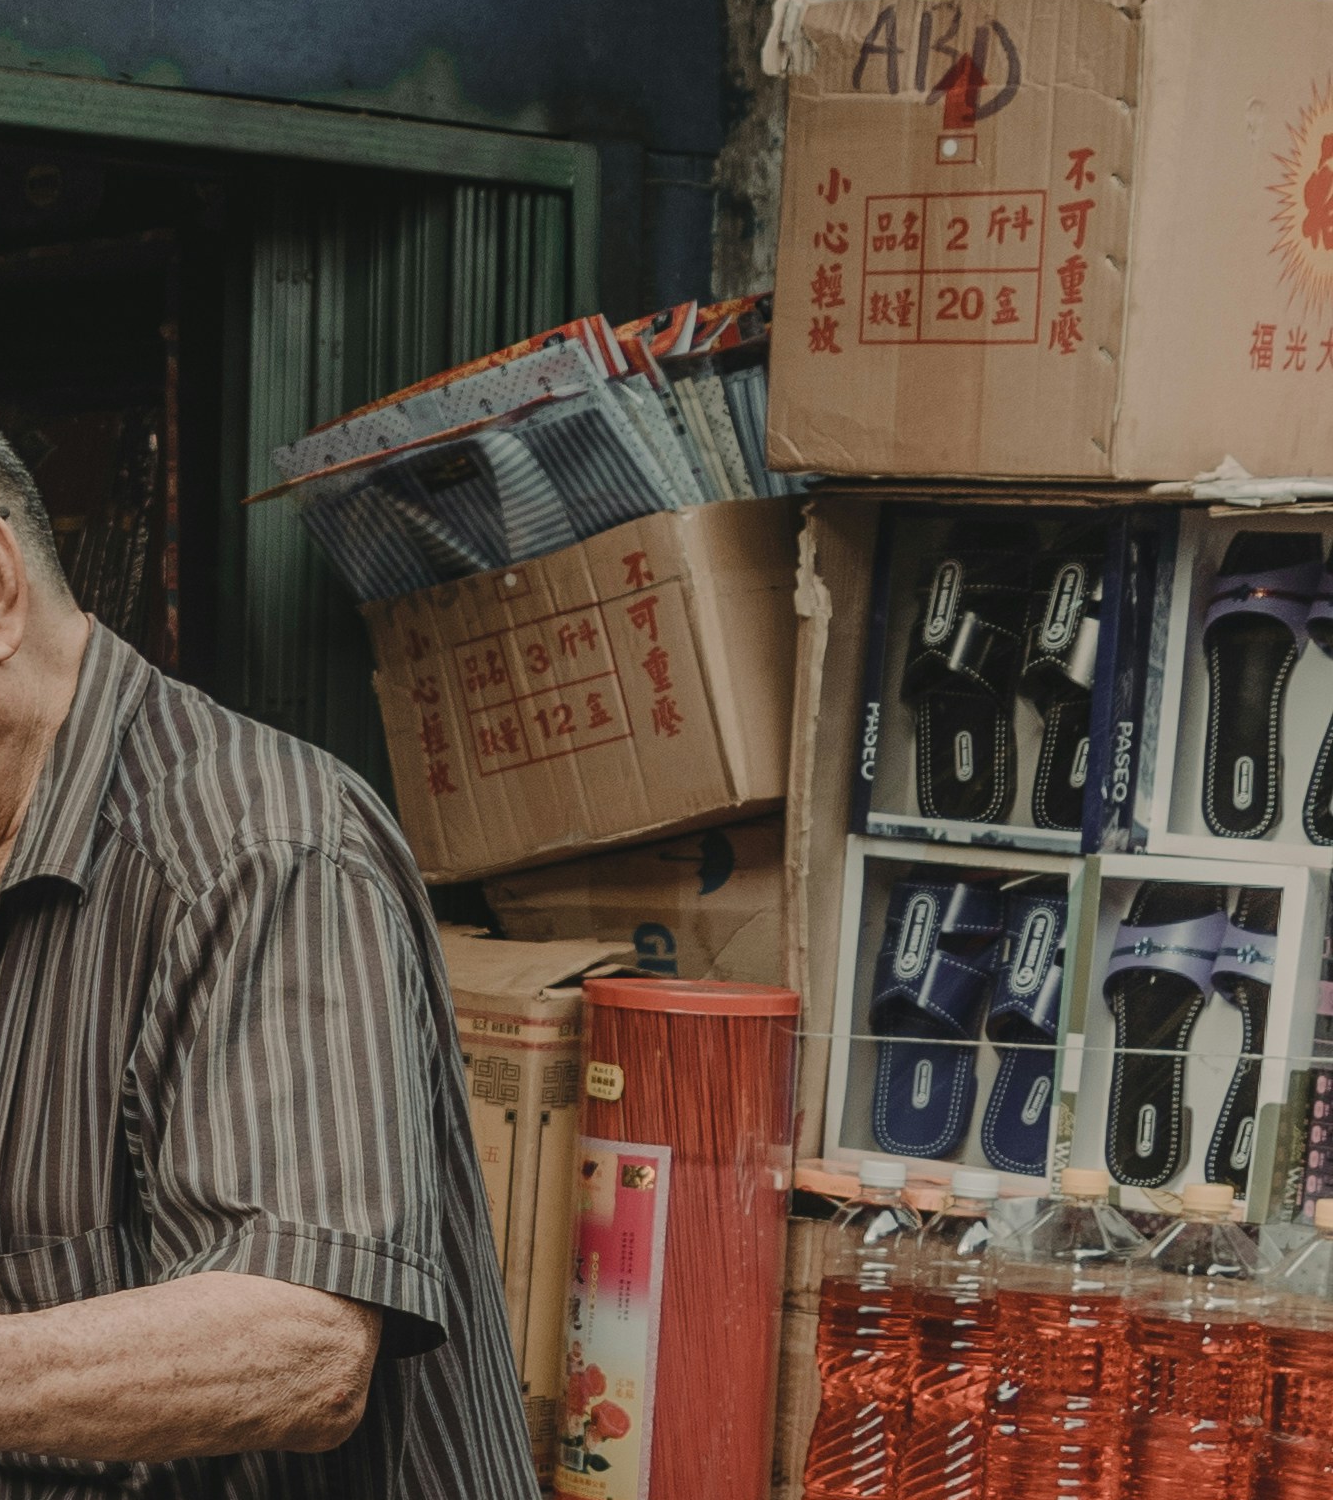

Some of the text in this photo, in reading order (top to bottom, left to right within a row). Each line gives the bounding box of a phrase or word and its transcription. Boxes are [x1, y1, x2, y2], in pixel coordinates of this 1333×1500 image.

[852, 2, 1022, 123] ABD
[872, 211, 921, 252] 品名
[946, 217, 970, 250] 2
[935, 286, 984, 322] 20
[526, 643, 551, 675] 3
[533, 703, 577, 740] 12
[1111, 720, 1133, 804] PASEO
